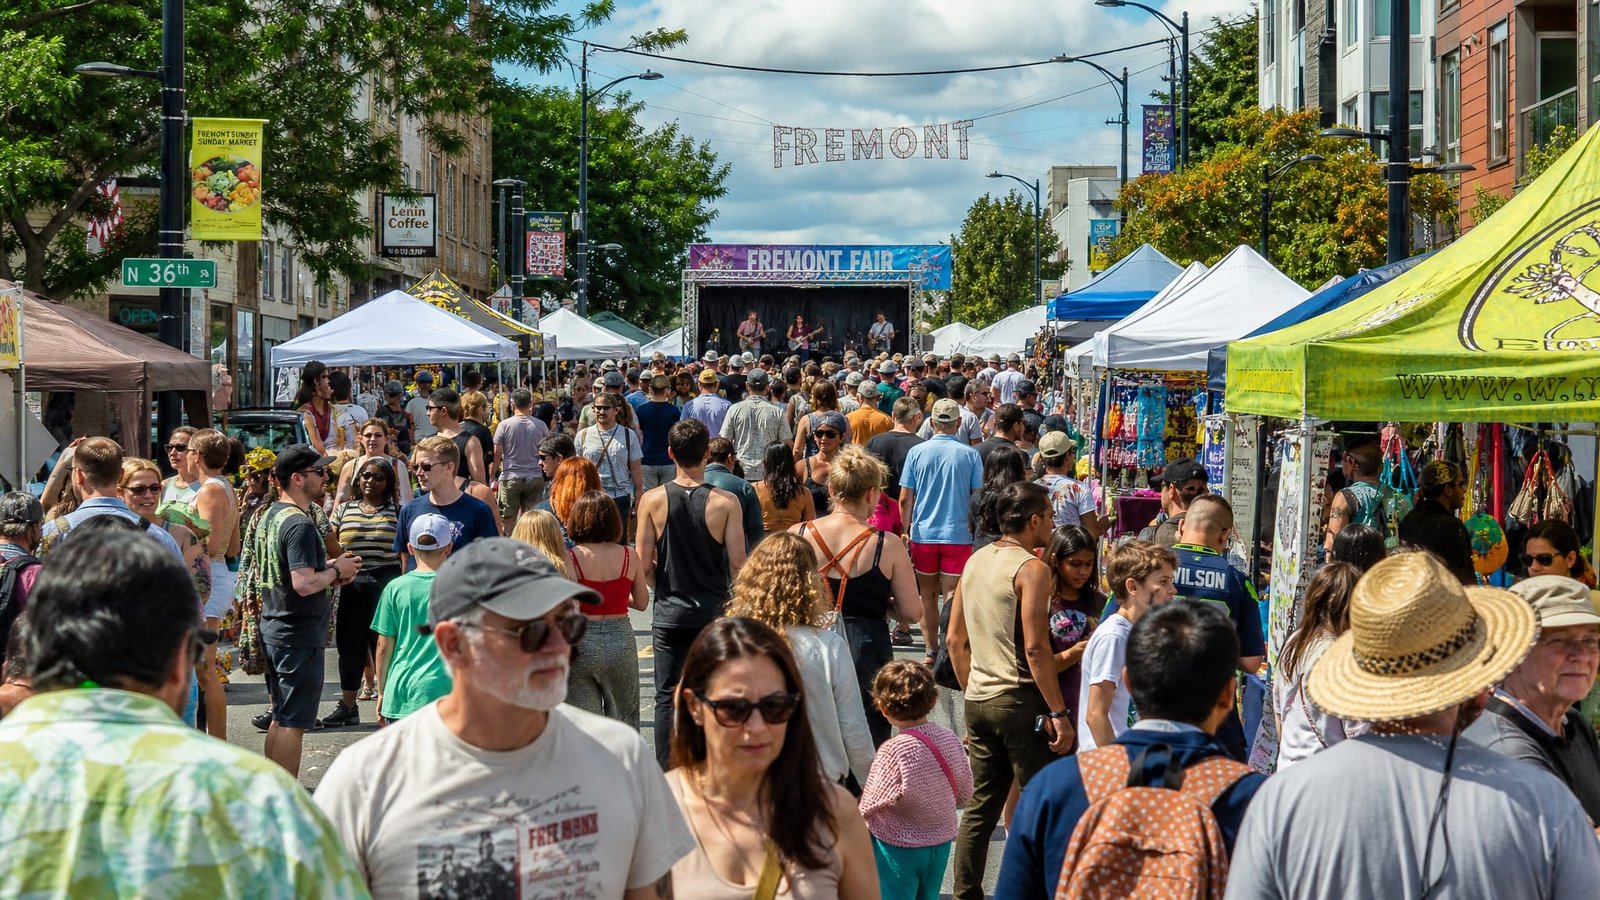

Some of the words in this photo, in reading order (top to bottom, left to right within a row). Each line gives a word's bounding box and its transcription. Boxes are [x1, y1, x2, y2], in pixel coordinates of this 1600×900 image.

[198, 138, 227, 146] SUNDAY
[228, 138, 258, 147] MARKET
[773, 120, 974, 168] FREMONT
[391, 205, 426, 217] Lenin
[388, 217, 430, 229] Coffee
[748, 249, 843, 271] FREMONT
[851, 249, 895, 271] FAIR
[127, 267, 139, 282] N
[148, 263, 190, 283] 36th
[120, 307, 159, 323] OPEN
